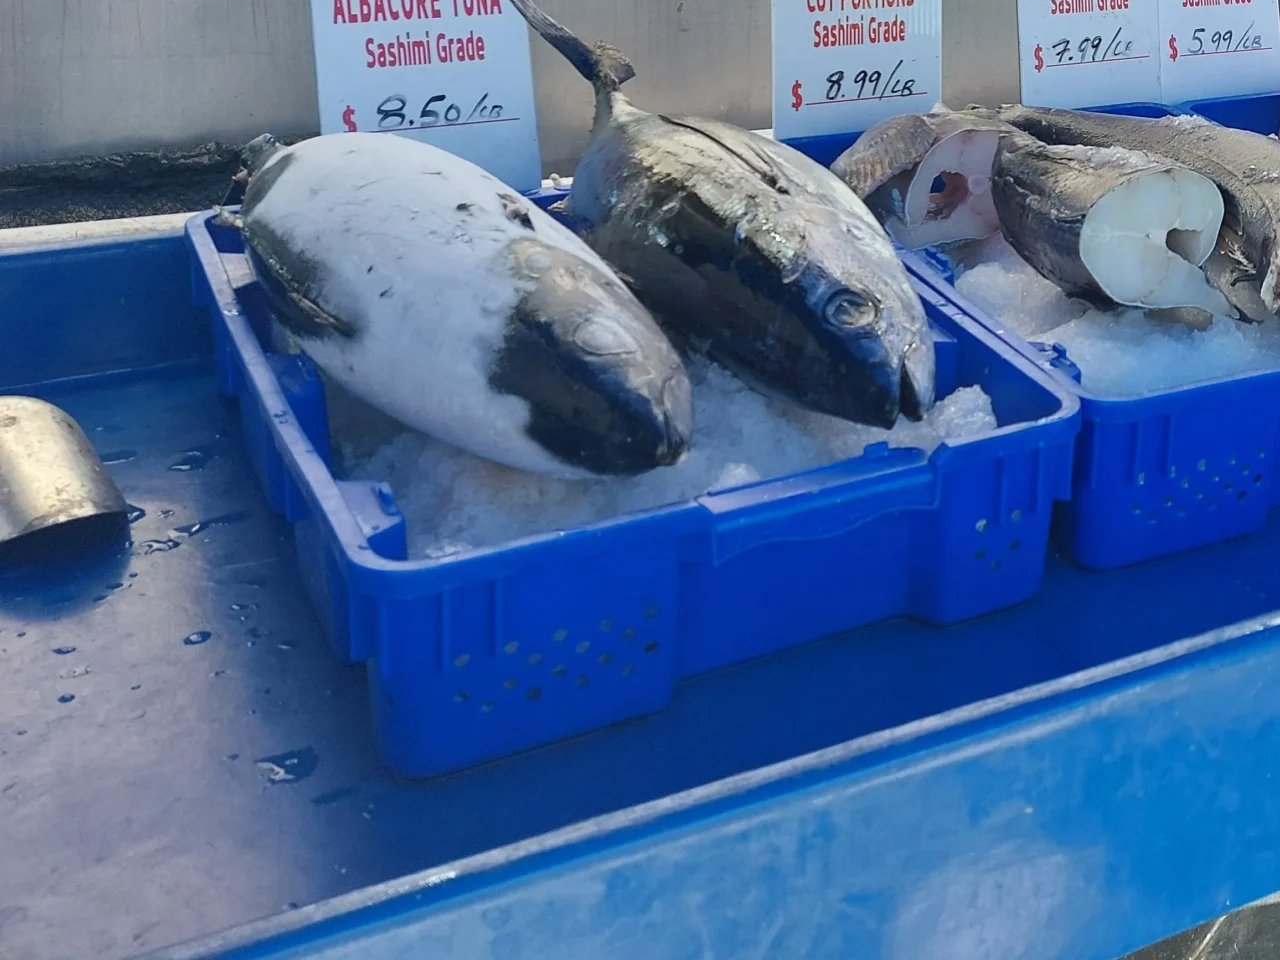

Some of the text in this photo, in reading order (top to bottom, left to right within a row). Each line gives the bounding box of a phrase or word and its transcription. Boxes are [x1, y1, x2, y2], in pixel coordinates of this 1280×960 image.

[813, 15, 905, 48] Sashimi Grade
[366, 30, 485, 68] Sashimi Grade
[1034, 44, 1044, 73] $
[1168, 34, 1178, 62] $
[791, 80, 802, 111] $
[342, 105, 358, 132] $
